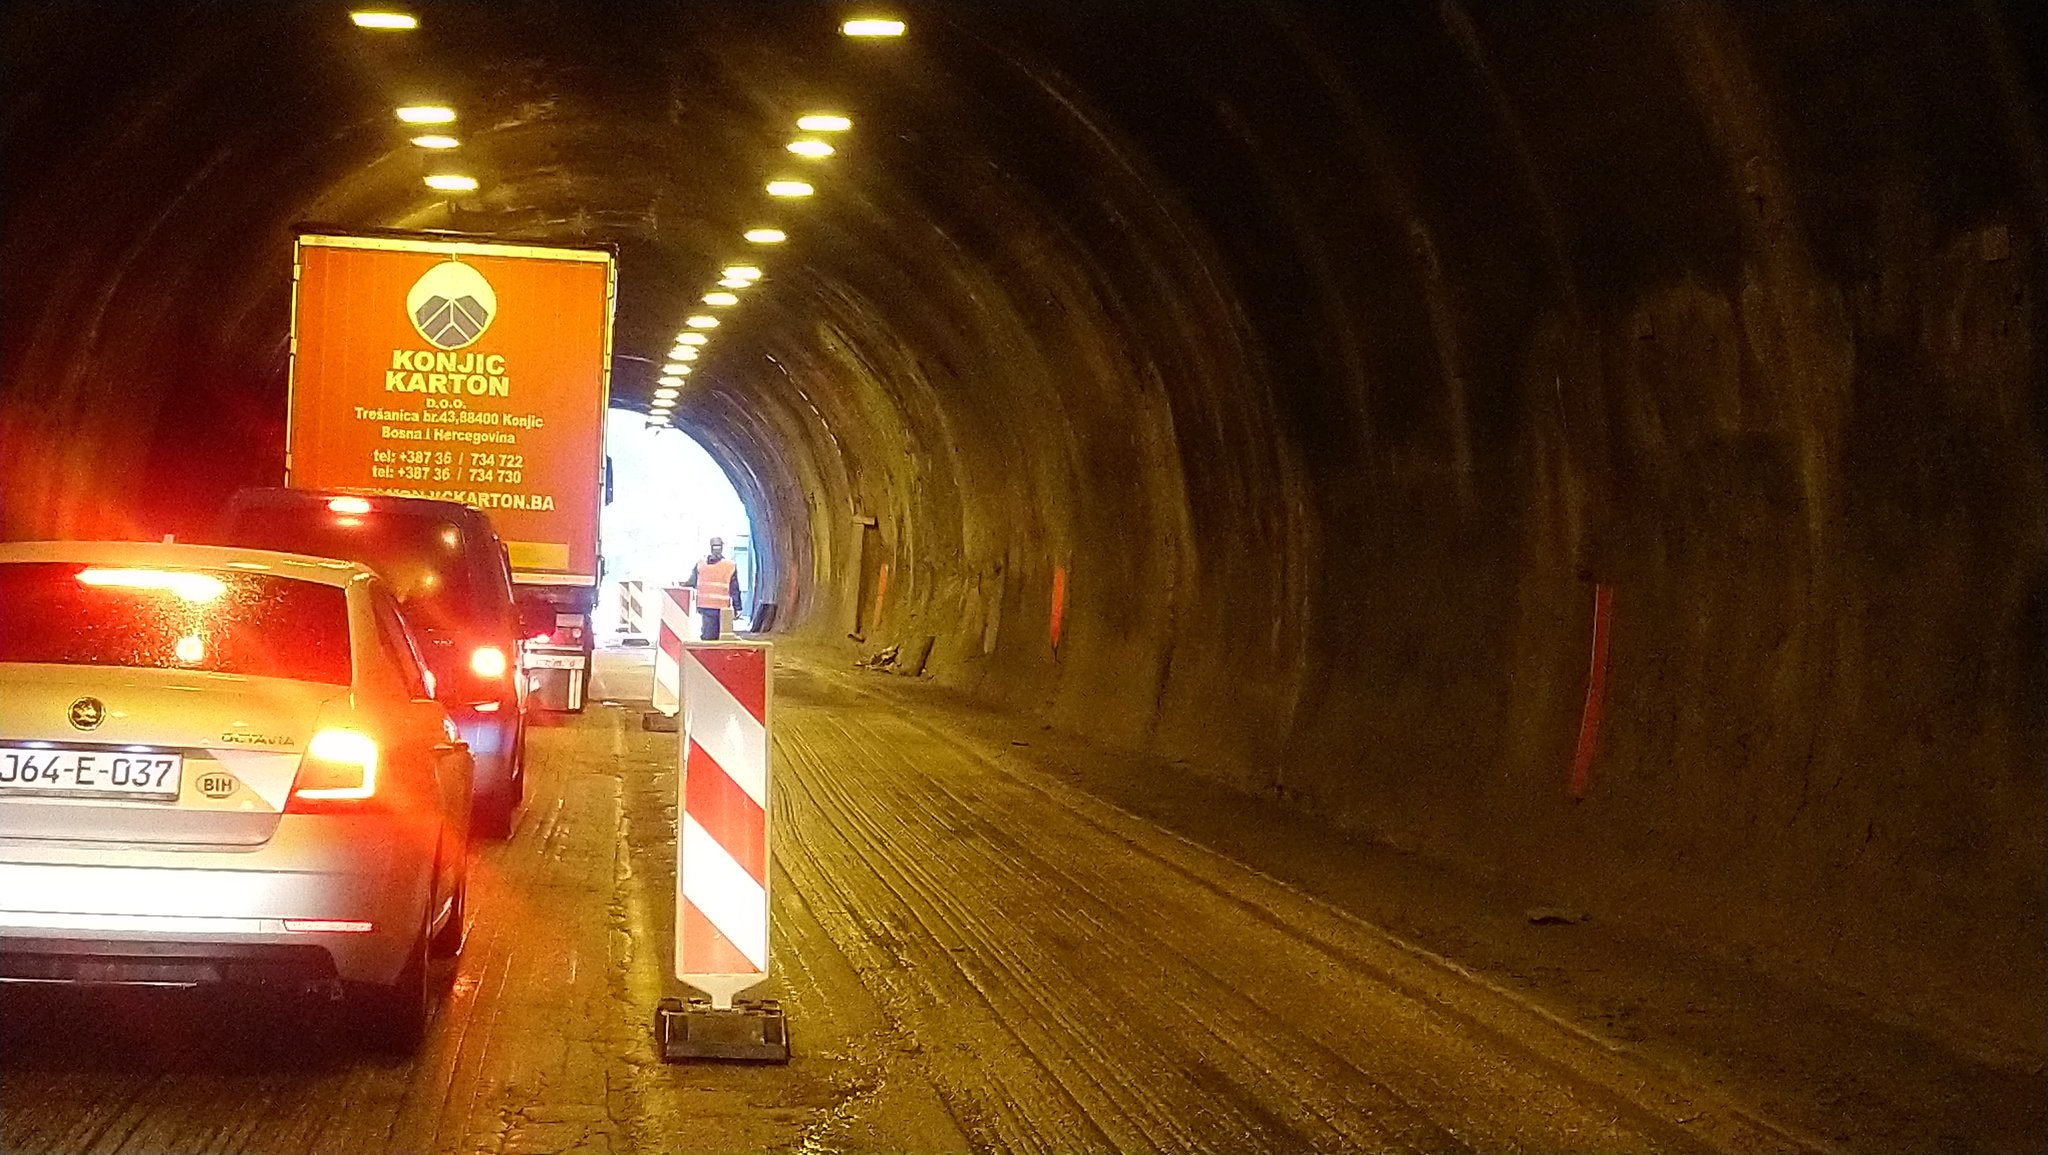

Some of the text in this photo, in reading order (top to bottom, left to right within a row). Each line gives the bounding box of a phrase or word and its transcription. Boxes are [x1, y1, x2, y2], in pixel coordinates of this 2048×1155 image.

[393, 349, 506, 376] KONJIC
[385, 370, 510, 397] KARTON
[354, 406, 420, 422] Trešanica
[502, 413, 543, 430] Konjic
[381, 426, 422, 440] Bosna
[433, 428, 516, 445] Hercegovina
[373, 449, 396, 463] tel:
[400, 450, 432, 465] +387
[434, 451, 452, 465] 36
[470, 452, 496, 467] 734
[498, 454, 524, 469] 722
[372, 465, 394, 479] tel:
[397, 466, 430, 480] +387
[432, 467, 451, 481] 36
[468, 468, 494, 483] 734
[496, 469, 522, 484] 730
[221, 732, 295, 745] OCTAVIA
[0, 754, 174, 787] J64-E-037
[203, 778, 233, 792] BIH
